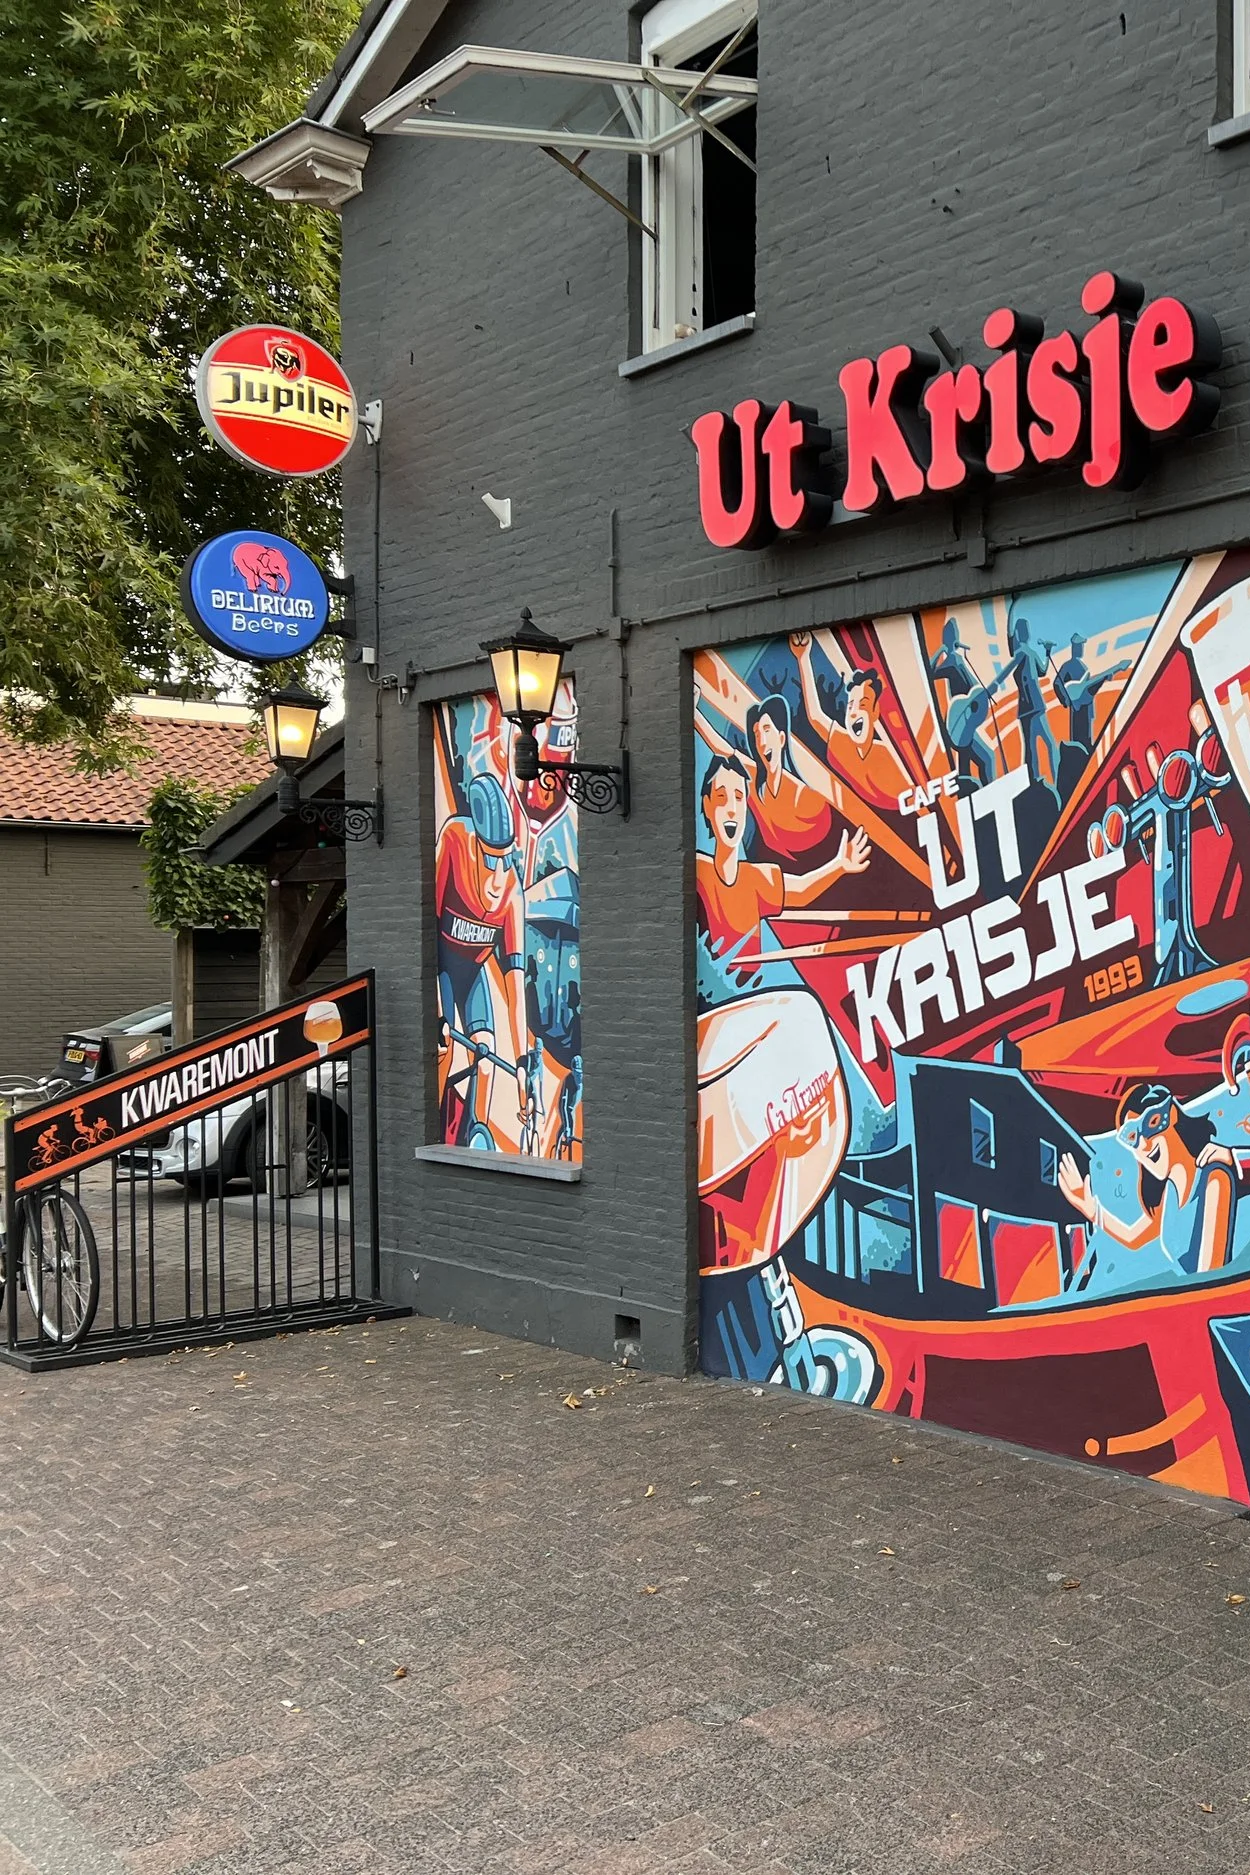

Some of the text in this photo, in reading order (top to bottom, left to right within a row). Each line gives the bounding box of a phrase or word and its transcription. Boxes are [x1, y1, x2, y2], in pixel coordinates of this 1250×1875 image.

[216, 371, 350, 423] Jupiler
[692, 270, 1194, 548] Ut Krisje
[211, 589, 315, 619] DELIRIUM
[232, 613, 299, 637] Beers
[916, 763, 1031, 910] UT
[451, 917, 497, 943] KWAREMONT
[845, 848, 1135, 1063] KRISJE
[1083, 954, 1144, 1003] 1993
[121, 1028, 279, 1129] KWAREMONT
